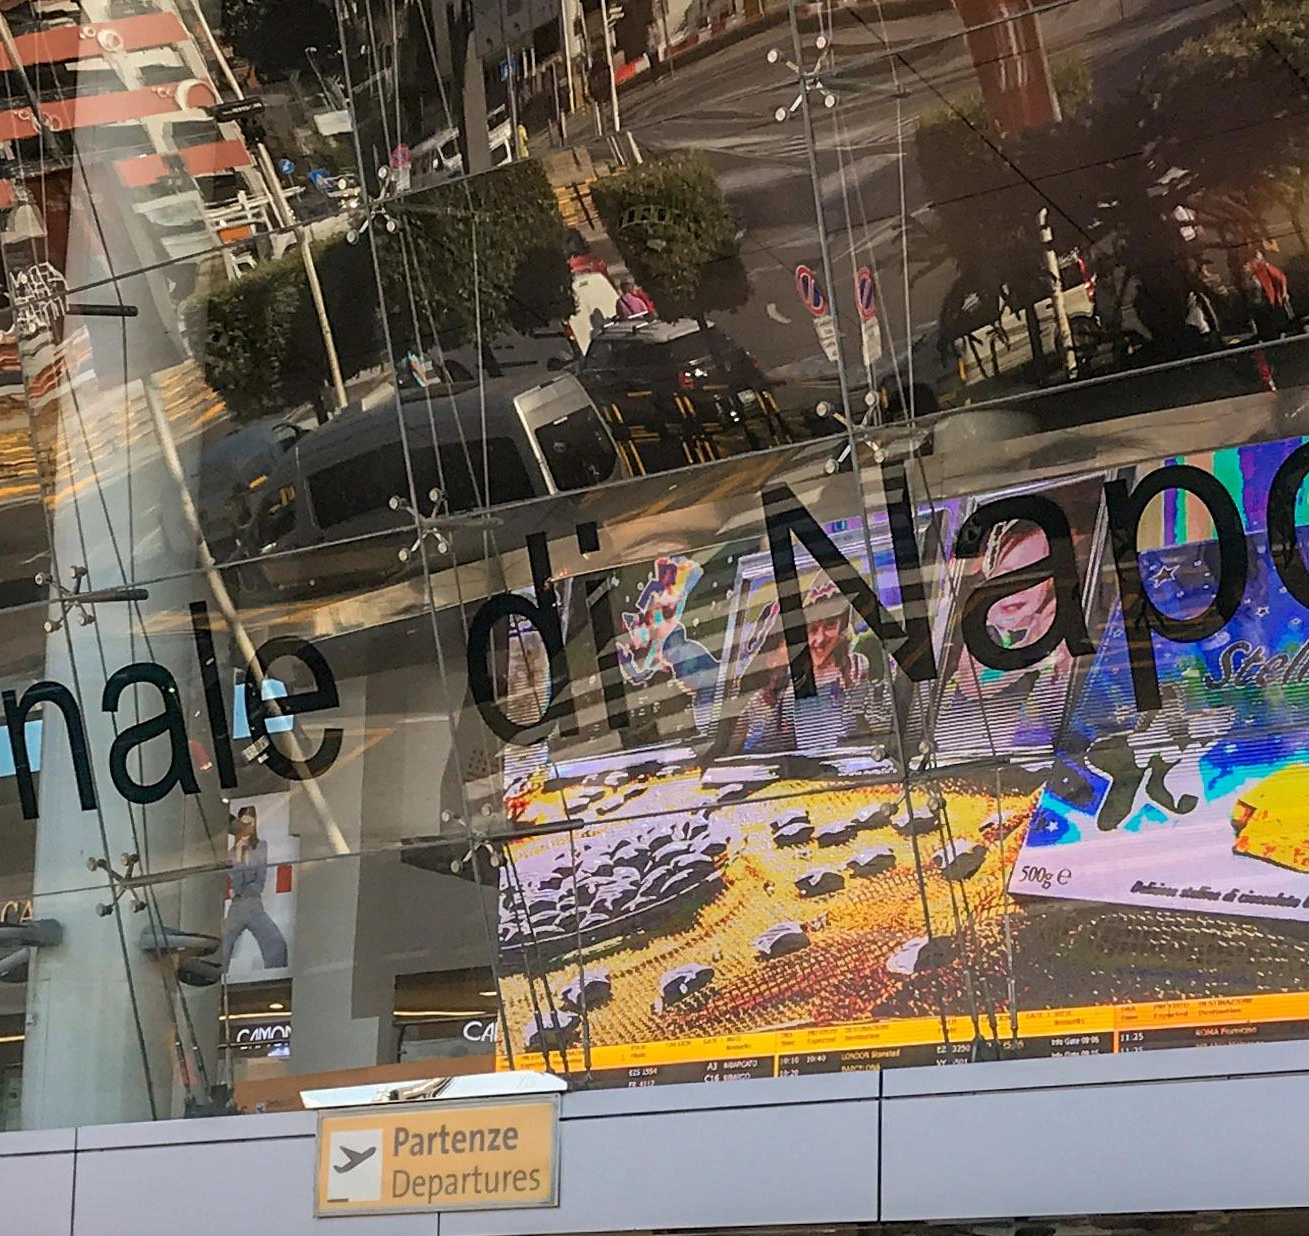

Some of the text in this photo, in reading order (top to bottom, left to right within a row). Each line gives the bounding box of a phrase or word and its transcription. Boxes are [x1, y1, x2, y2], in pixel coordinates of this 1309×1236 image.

[467, 520, 631, 747] di
[1020, 865, 1054, 890] 500g
[841, 1051, 870, 1061] LONDON
[392, 1124, 519, 1158] Partenze
[392, 1167, 540, 1204] Departures
